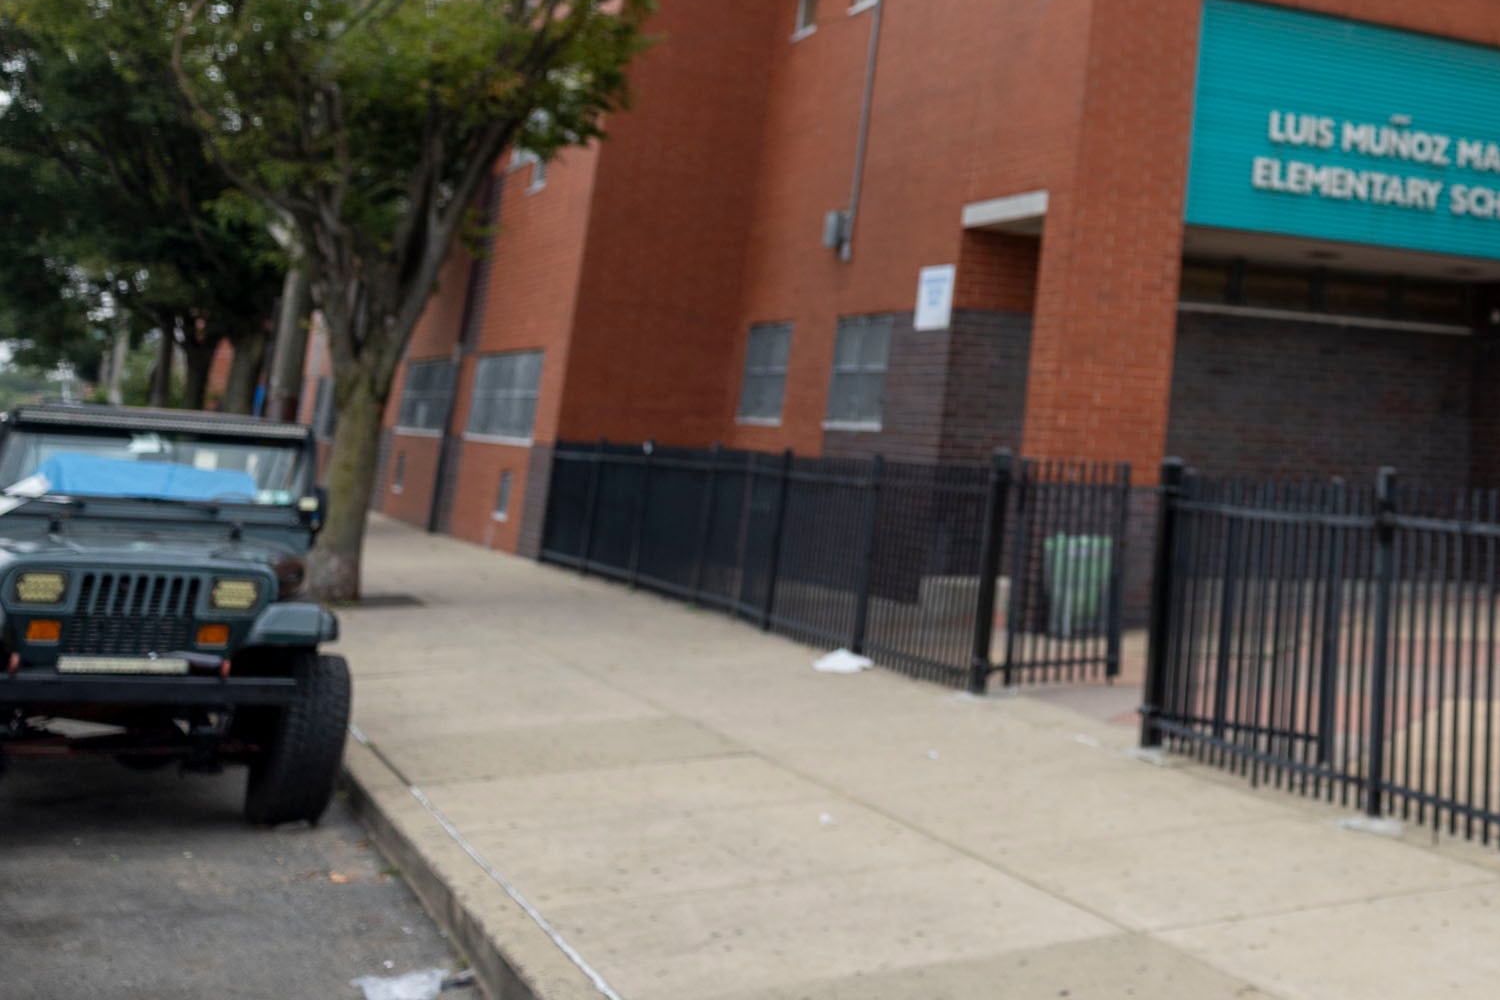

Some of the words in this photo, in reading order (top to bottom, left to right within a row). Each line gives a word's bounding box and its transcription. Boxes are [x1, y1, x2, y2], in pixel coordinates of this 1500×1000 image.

[1268, 110, 1335, 149] LUIS
[1341, 113, 1450, 166] MUÑOZ
[1252, 156, 1443, 210] ELEMENTARY
